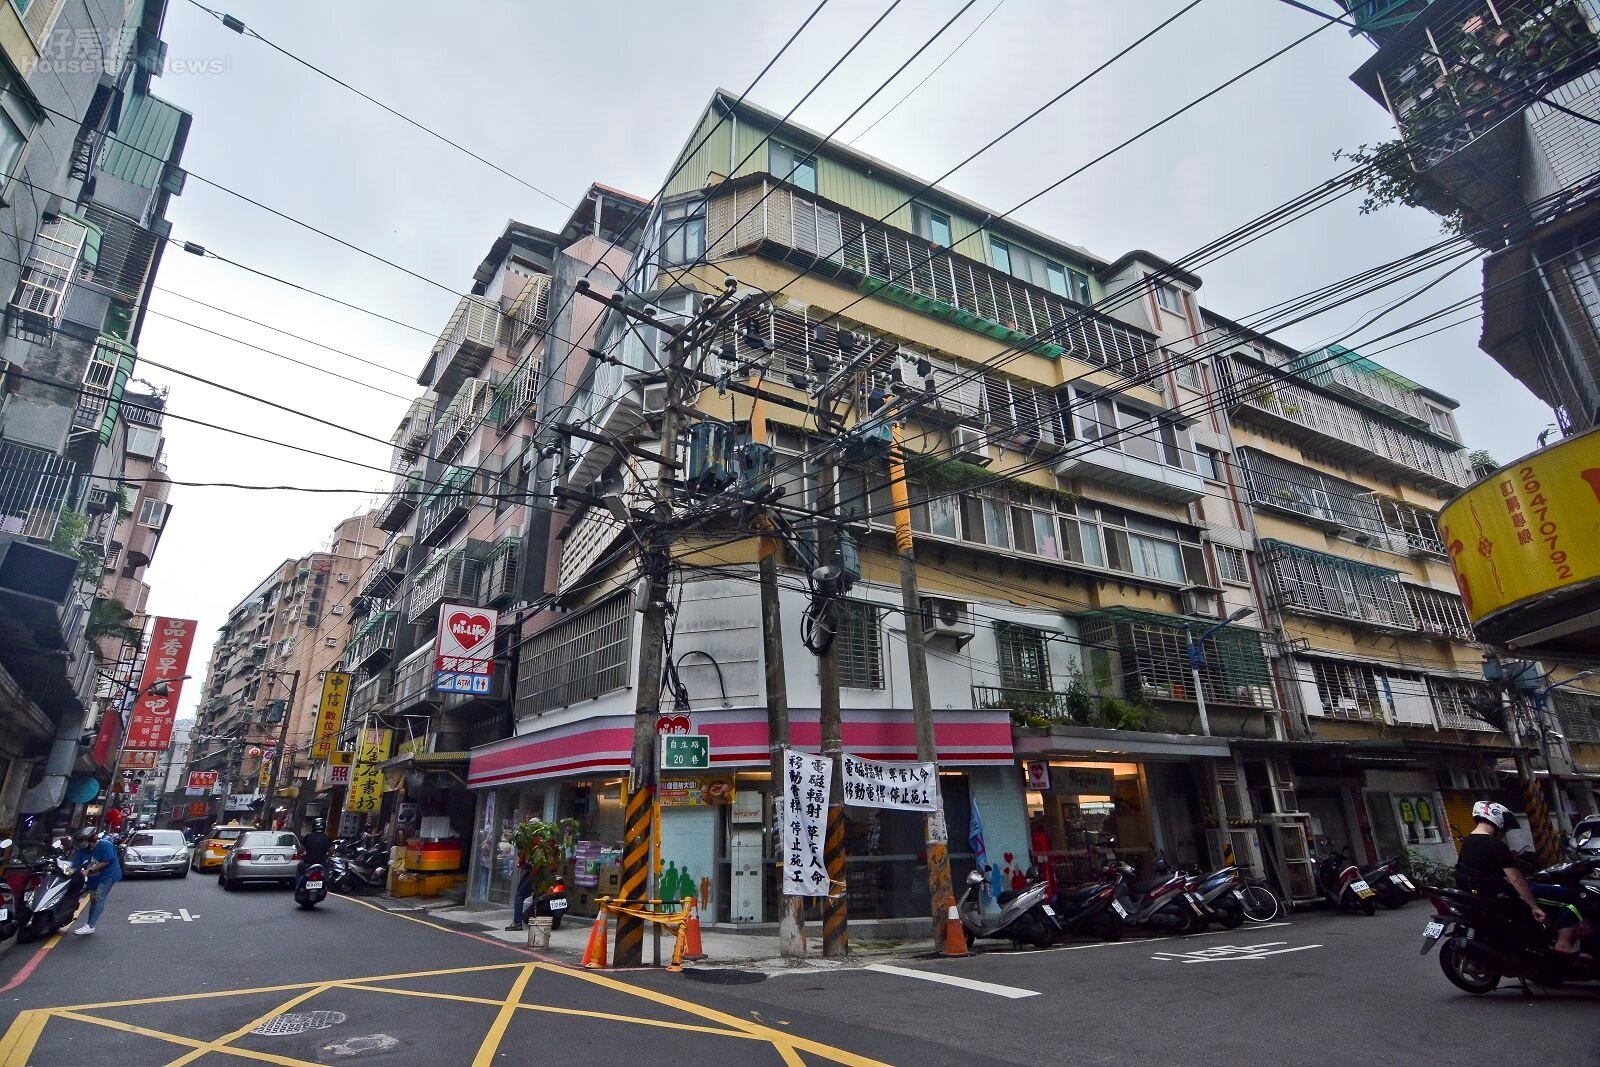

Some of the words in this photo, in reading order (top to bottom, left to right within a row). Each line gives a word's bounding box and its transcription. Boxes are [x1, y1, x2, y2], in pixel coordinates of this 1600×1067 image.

[1501, 480, 1533, 545] 訂購專線
[1519, 466, 1573, 580] 29470792
[457, 679, 471, 688] ATM
[670, 740, 700, 749] 自立路
[332, 766, 349, 780] 照
